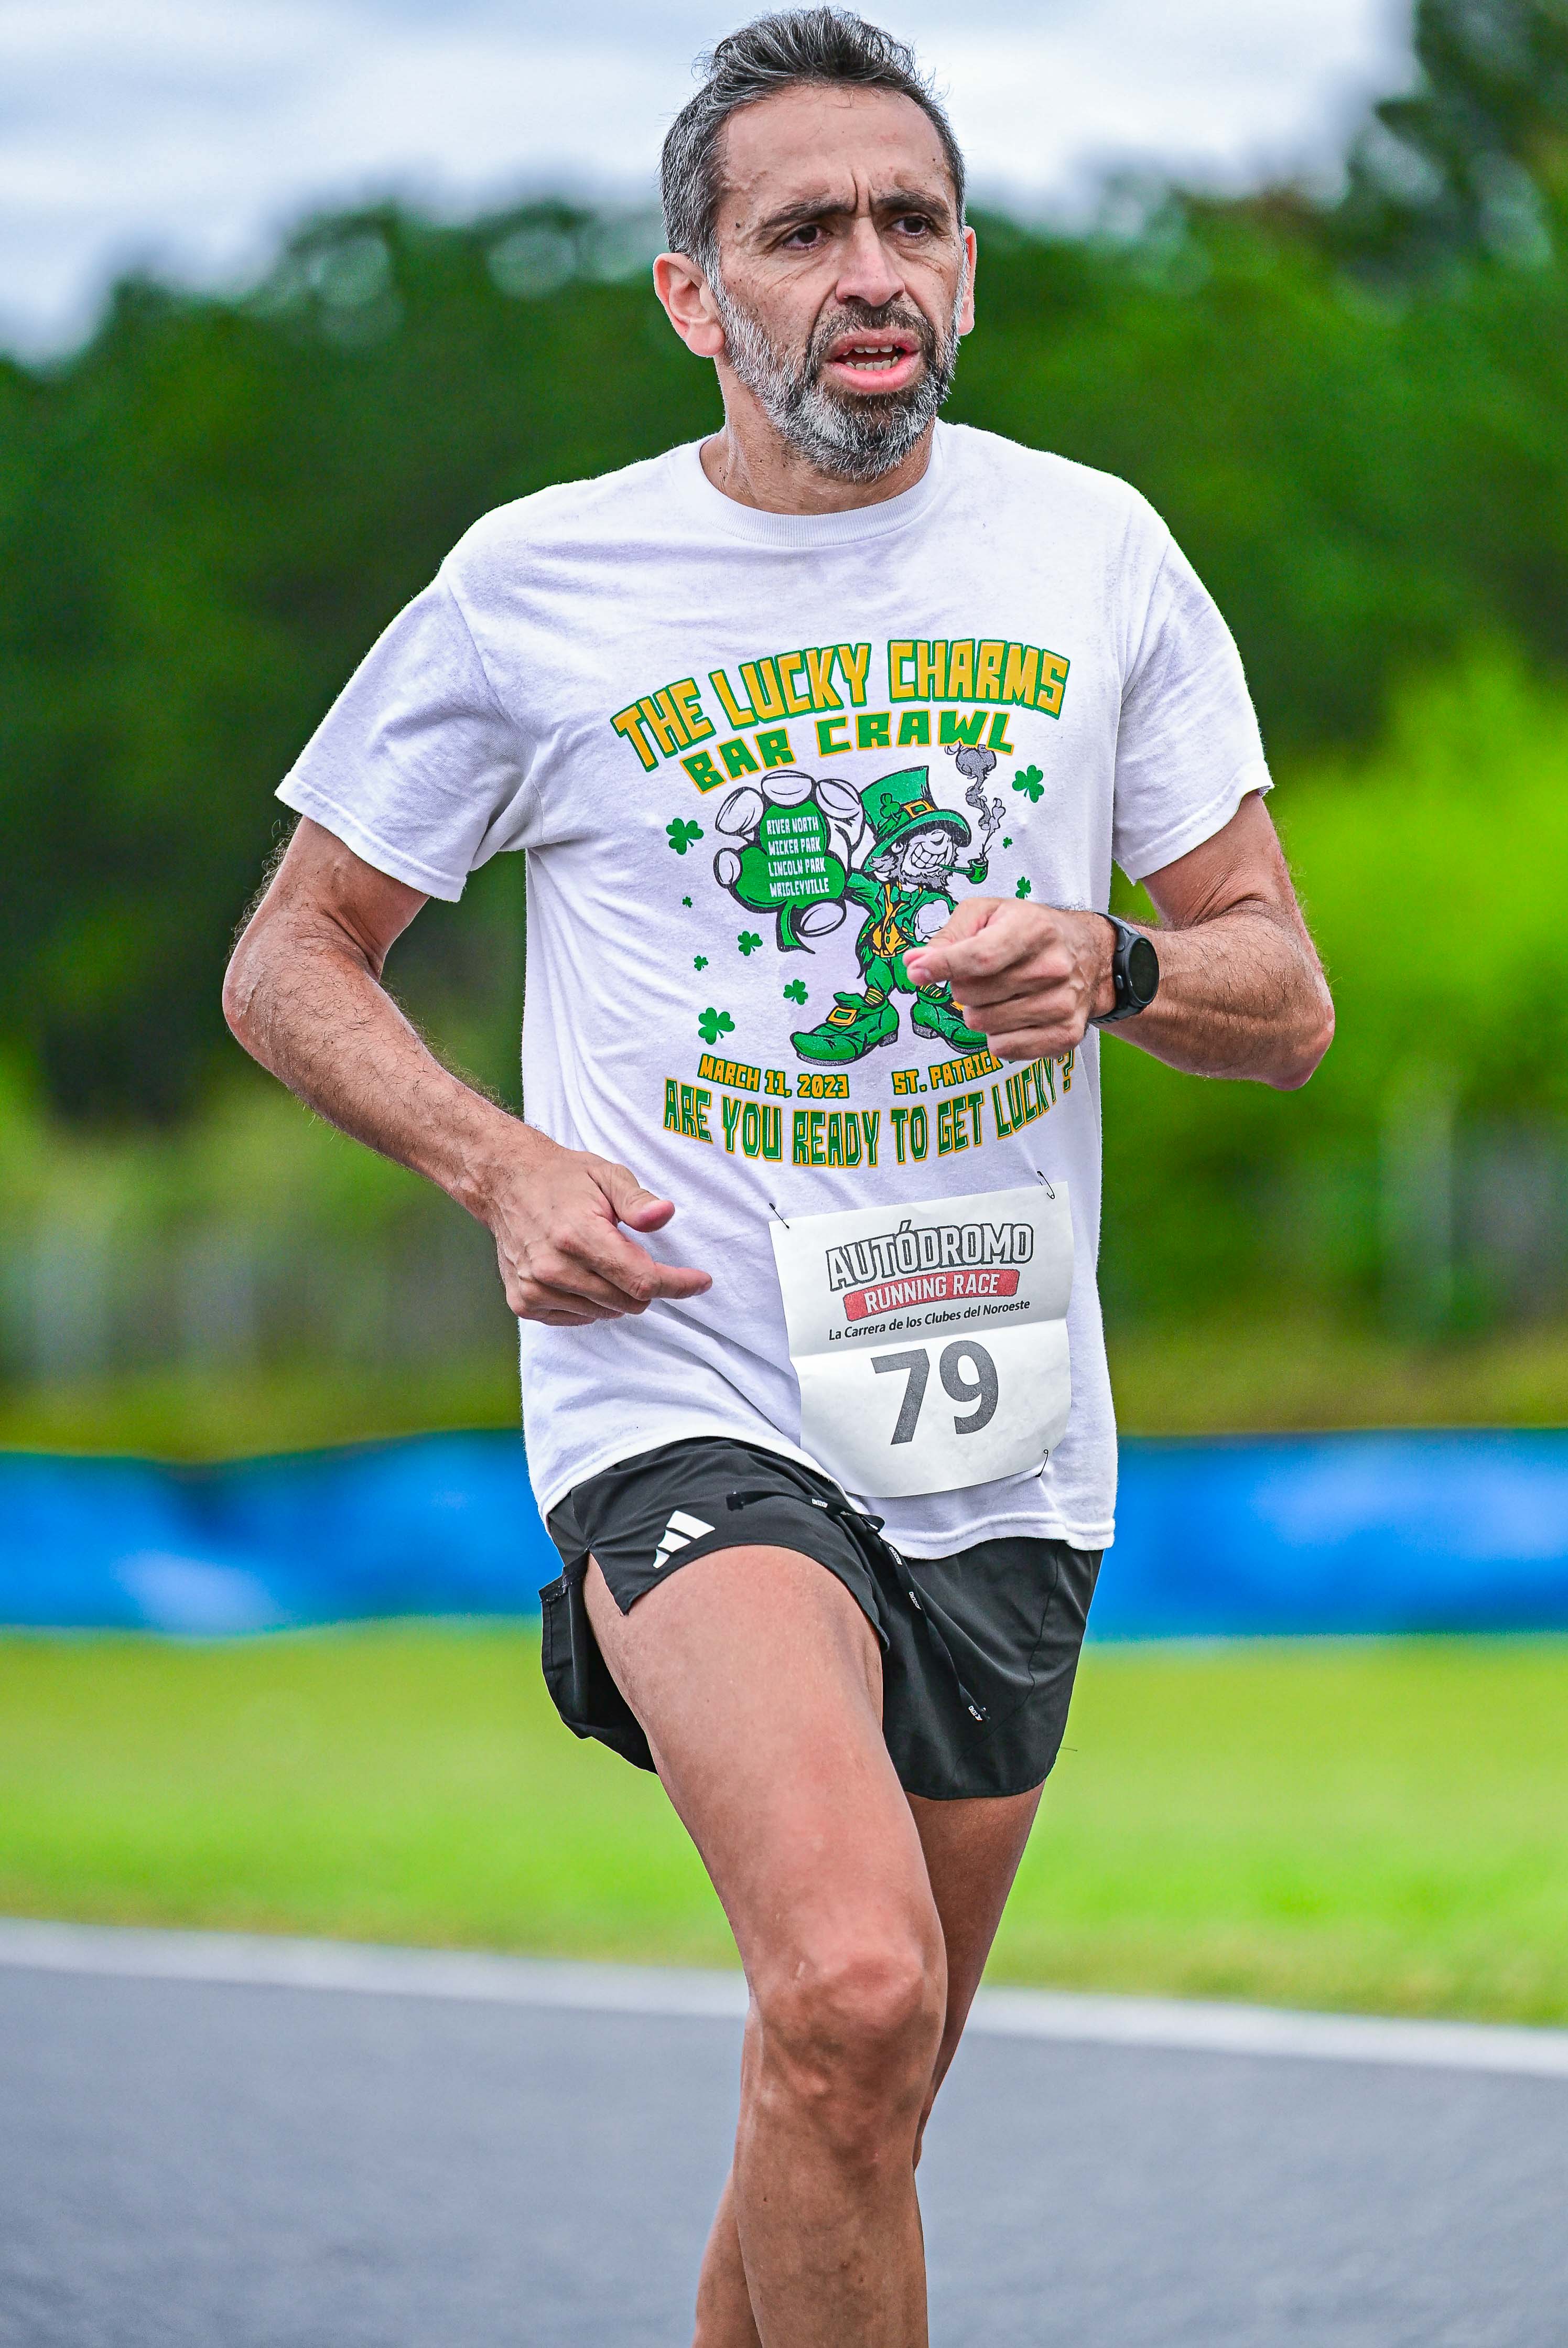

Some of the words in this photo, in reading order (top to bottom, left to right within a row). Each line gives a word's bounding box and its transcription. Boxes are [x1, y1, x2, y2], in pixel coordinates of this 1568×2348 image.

[610, 677, 716, 771] THE
[709, 643, 871, 729] LUCKY
[888, 639, 1070, 719] CHARMS
[680, 727, 796, 794] BAR
[815, 709, 1015, 756] CRAWL
[766, 818, 791, 835] RIVER
[792, 816, 819, 833] NORTH
[768, 839, 799, 856] WICKER
[801, 837, 821, 853] PARK
[768, 859, 803, 877] LINCOLN
[805, 857, 826, 874] PARK
[770, 878, 830, 897] WRIGLEYVILLE
[698, 1054, 761, 1092] MARCH
[766, 1070, 792, 1098] 11,
[797, 1074, 850, 1098] 2023
[891, 1069, 927, 1095] ST.
[663, 1078, 713, 1144] ARE
[722, 1095, 783, 1162] YOU
[793, 1110, 880, 1169] READY
[890, 1105, 929, 1164] TO
[937, 1090, 985, 1158] GET
[826, 1220, 1033, 1291] AUTÓDROMO
[864, 1277, 946, 1314] RUNNING
[953, 1274, 999, 1295] RACE
[829, 1329, 842, 1340] La
[845, 1323, 885, 1338] Carrera
[889, 1319, 903, 1330] de
[906, 1316, 922, 1328] los
[925, 1311, 962, 1326] Clubes
[964, 1306, 980, 1318] del
[983, 1300, 1030, 1316] Noroeste
[871, 1340, 999, 1445] 79
